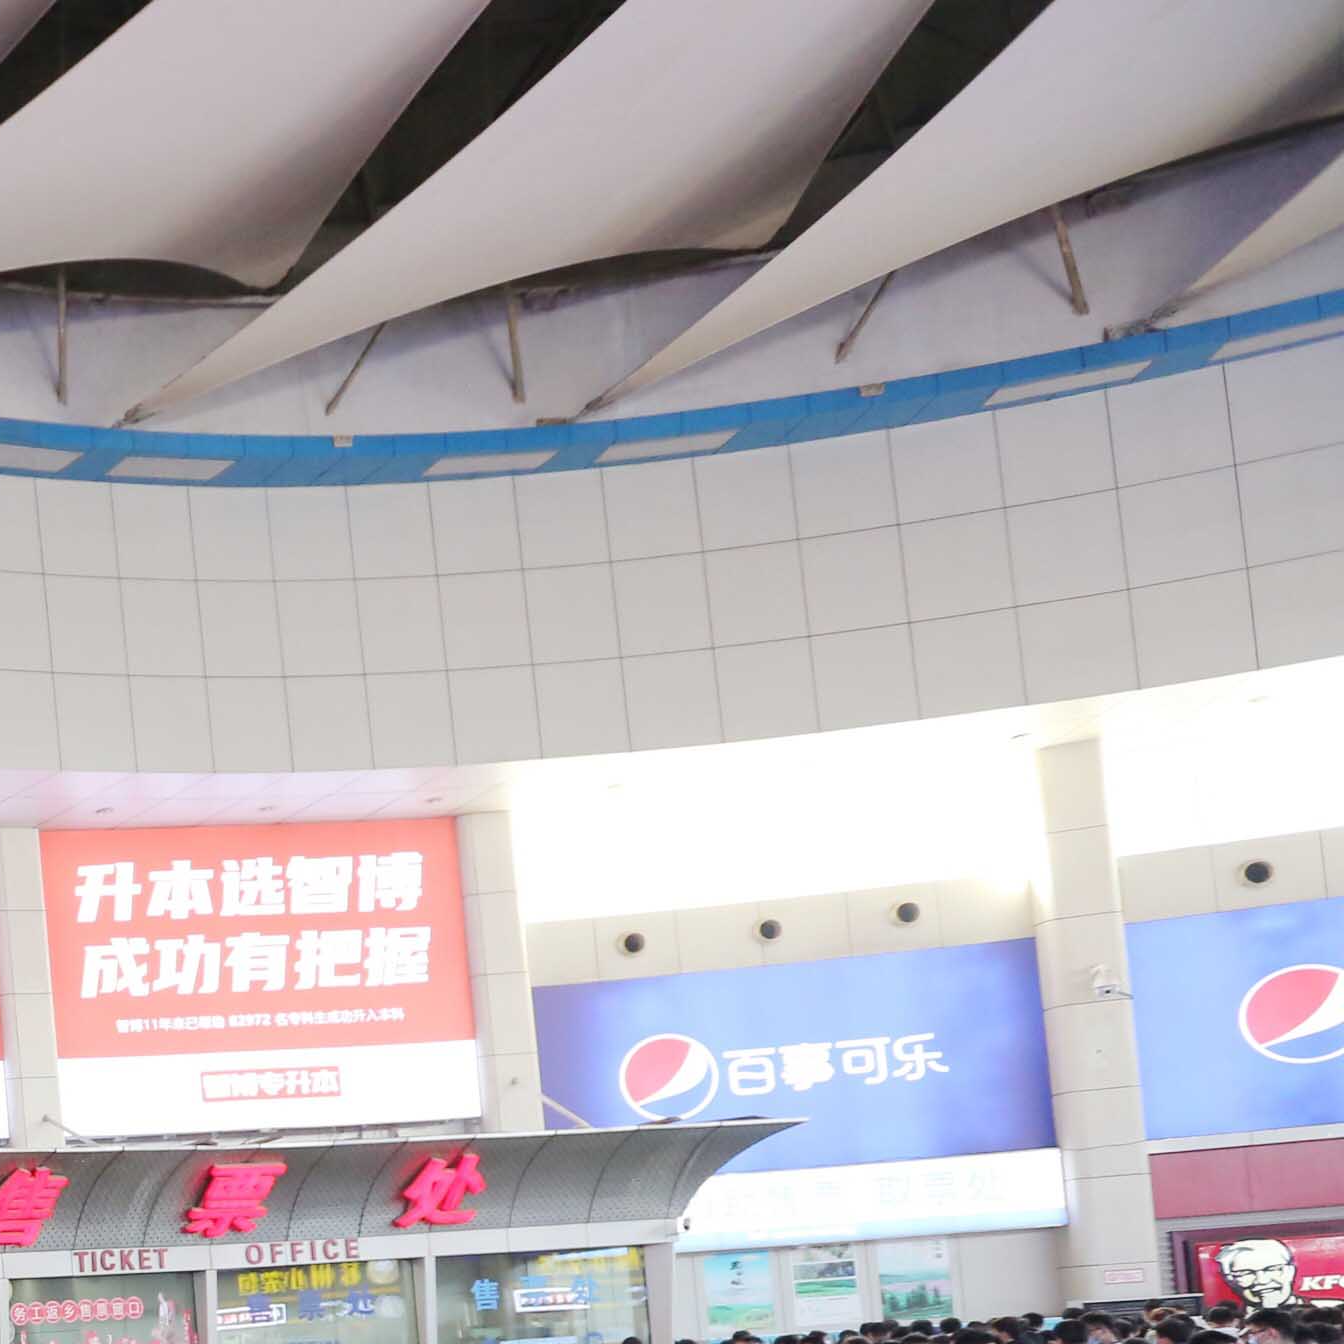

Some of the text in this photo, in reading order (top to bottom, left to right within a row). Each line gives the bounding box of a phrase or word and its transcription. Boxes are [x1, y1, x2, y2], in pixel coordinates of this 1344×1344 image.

[74, 852, 423, 923] 升本选智博
[80, 926, 432, 999] 成功有把握
[723, 1032, 950, 1097] 百事可乐
[73, 1238, 361, 1273] TICKET OFFICE
[1300, 1275, 1344, 1291] KF
